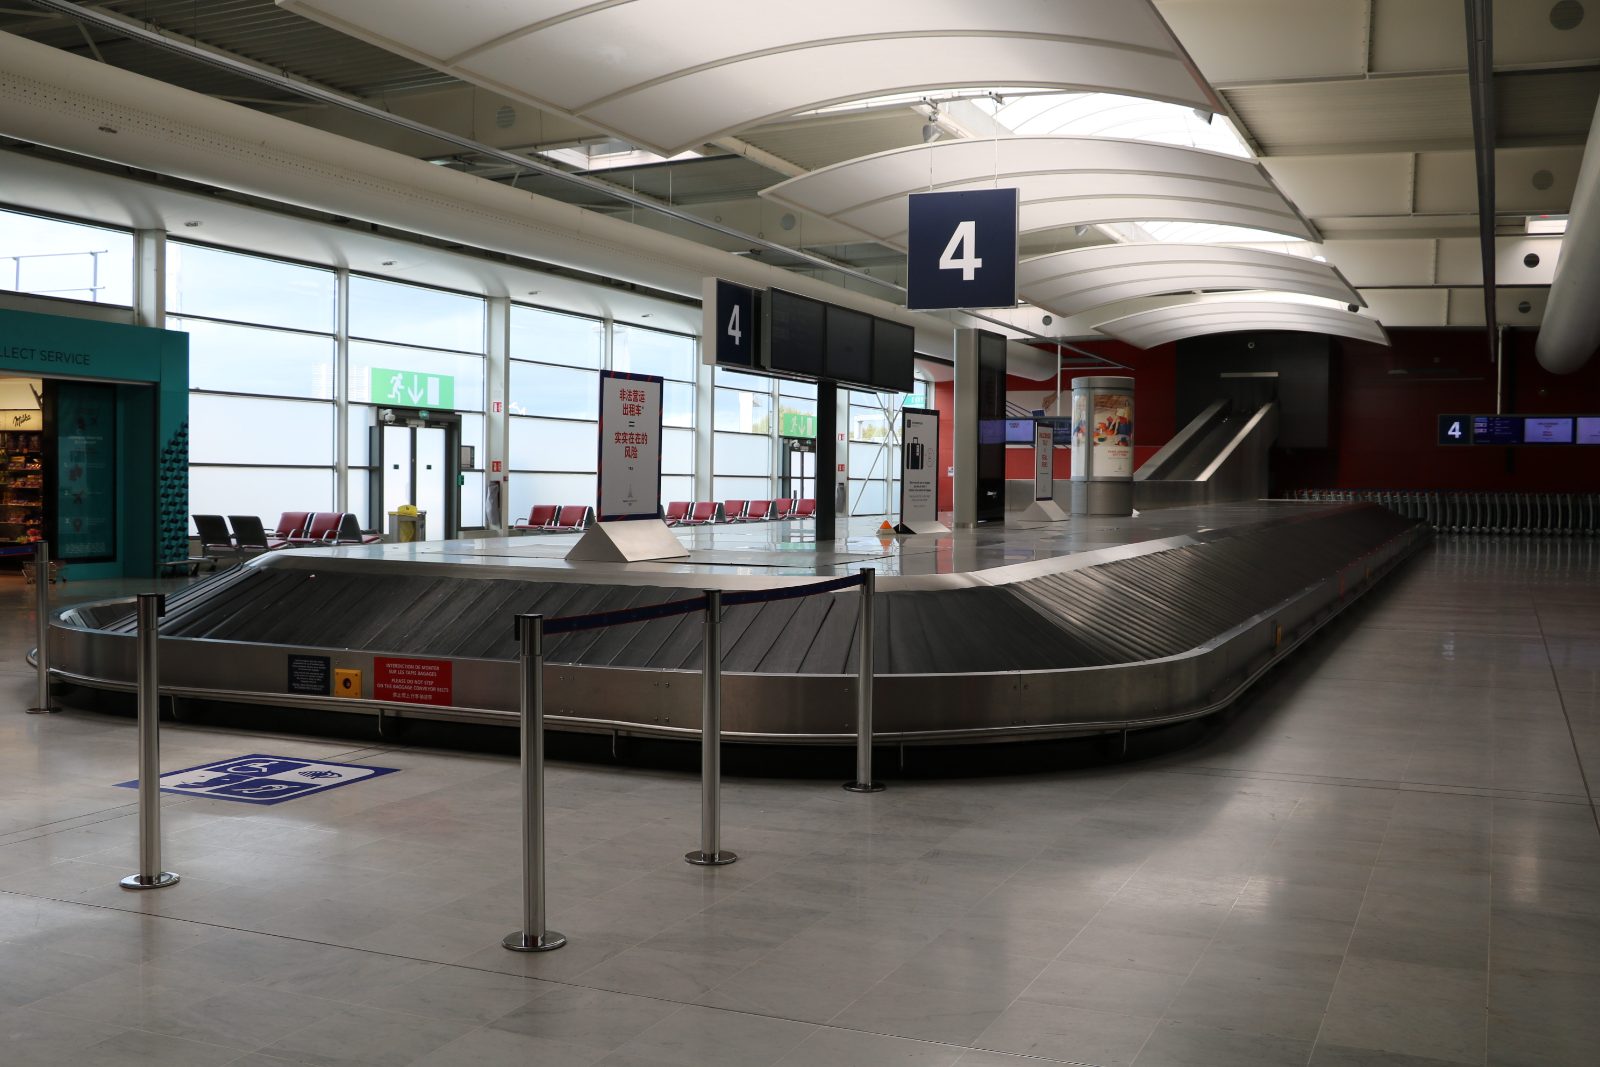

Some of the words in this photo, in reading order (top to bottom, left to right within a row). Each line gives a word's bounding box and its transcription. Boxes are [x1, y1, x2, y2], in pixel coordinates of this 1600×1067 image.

[939, 220, 983, 281] 4
[727, 304, 742, 345] 4
[0, 346, 36, 360] LECT
[40, 350, 91, 366] SERVICE
[619, 388, 646, 403] 非法营运
[614, 431, 648, 445] 实实在在的
[1447, 421, 1462, 439] 4
[624, 446, 638, 459] 风险
